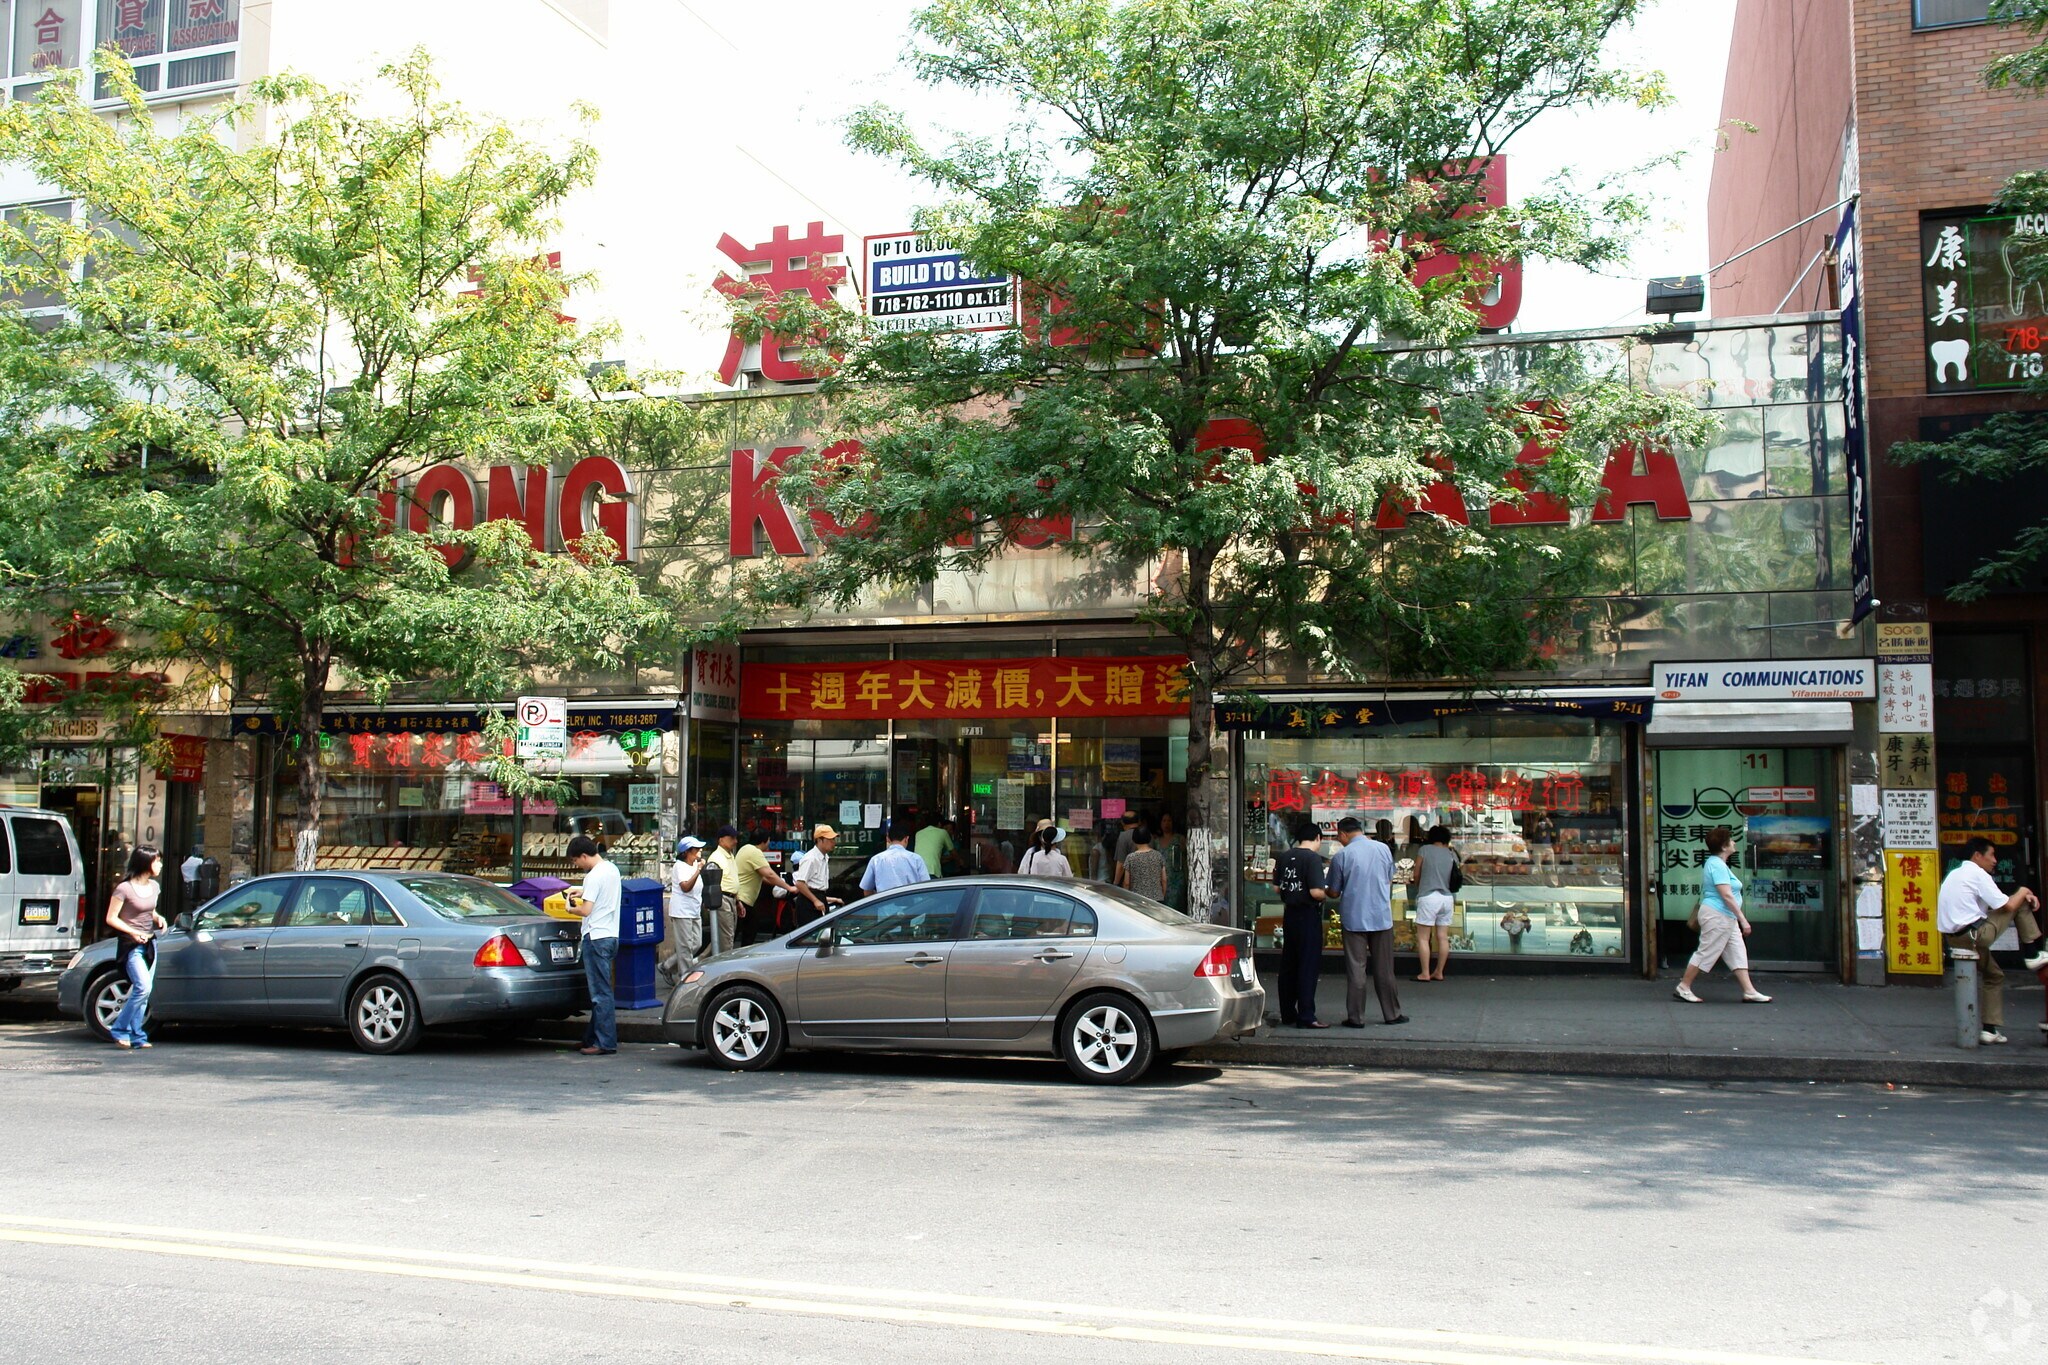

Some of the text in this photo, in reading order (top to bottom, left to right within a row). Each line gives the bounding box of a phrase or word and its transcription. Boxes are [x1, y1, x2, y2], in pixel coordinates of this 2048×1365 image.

[34, 8, 64, 44] 合
[172, 20, 238, 46] ASSOCIATION
[874, 243, 891, 256] UP
[895, 240, 911, 254] TO
[880, 263, 930, 287] BUILD
[933, 260, 956, 282] TO
[1926, 225, 1969, 327] 康美
[712, 221, 849, 389] 港
[879, 292, 964, 313] 718-762-1110
[945, 310, 1008, 326] REALTY
[1665, 669, 1864, 688] YIFAN COMMUNICATIONS
[1791, 689, 1865, 698] Yifanmall.com
[1900, 669, 1916, 723] 培訓中心
[1613, 701, 1643, 715] 37-11
[588, 715, 604, 726] INC.
[1899, 774, 1915, 786] 2A
[1771, 881, 1801, 892] SHOE
[1766, 892, 1807, 904] REPAIR
